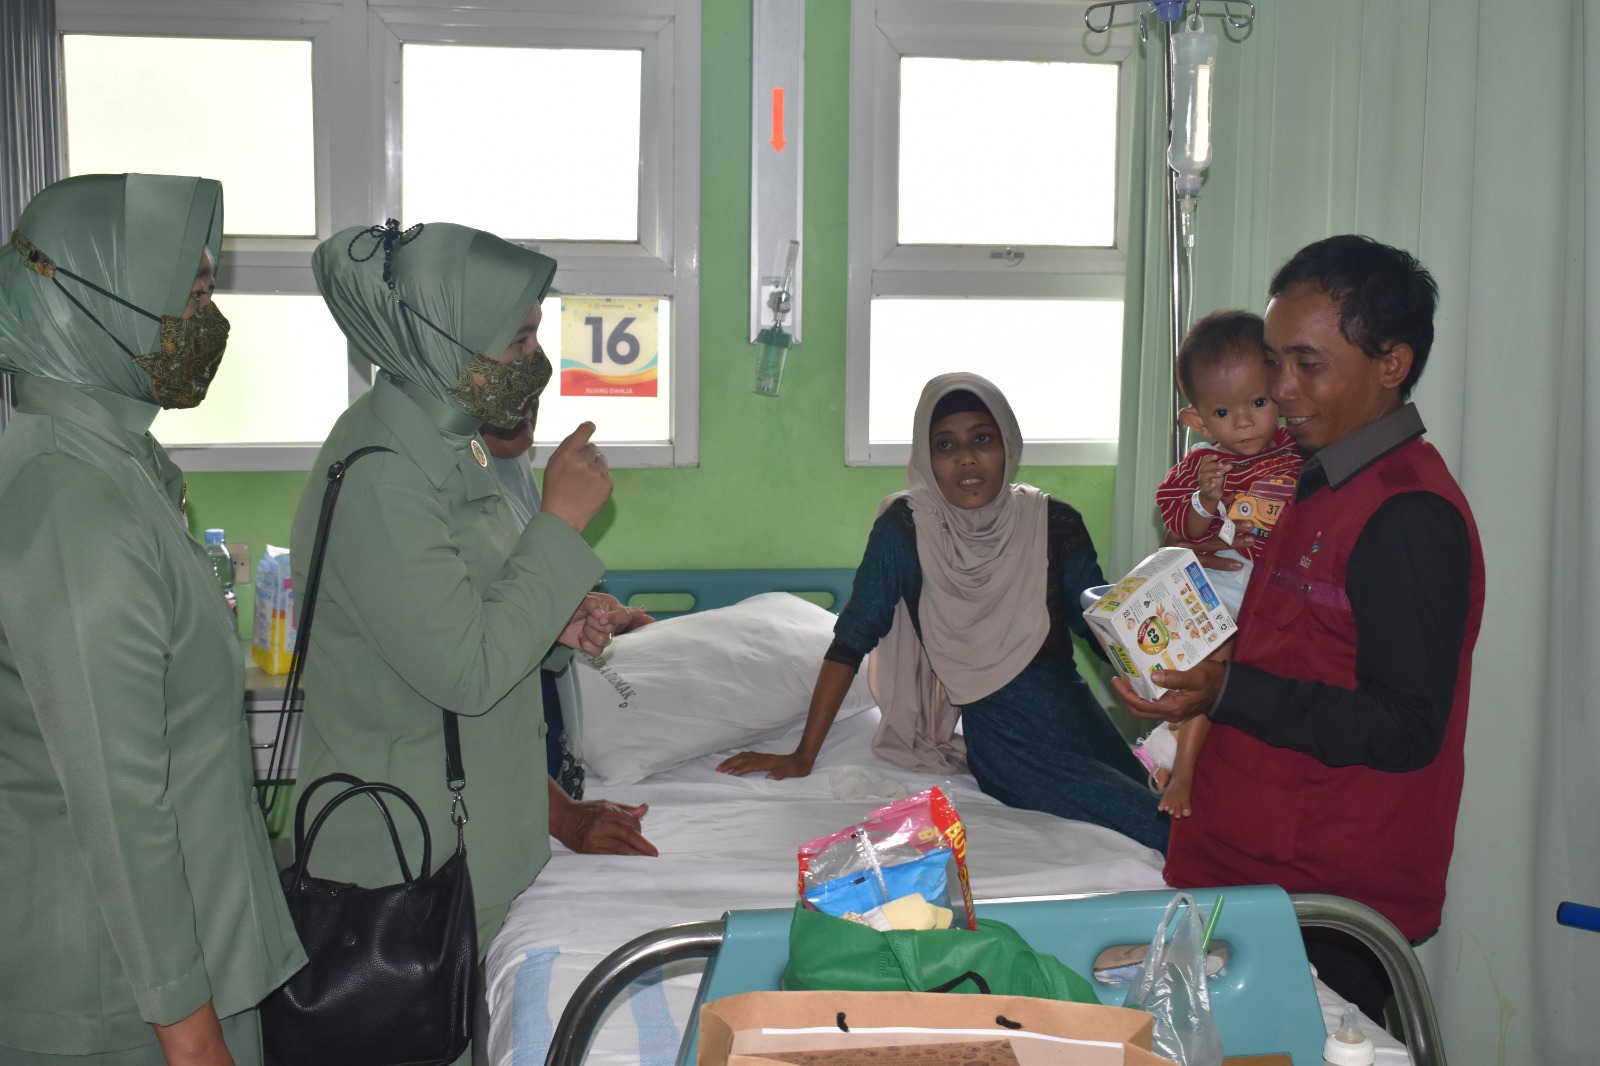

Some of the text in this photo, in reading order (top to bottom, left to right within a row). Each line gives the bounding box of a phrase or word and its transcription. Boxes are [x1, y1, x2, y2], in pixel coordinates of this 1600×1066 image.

[586, 317, 640, 365] 16
[586, 387, 633, 395] RUANG DAHLIA
[1266, 503, 1280, 515] 37
[603, 672, 637, 700] DEMAK
